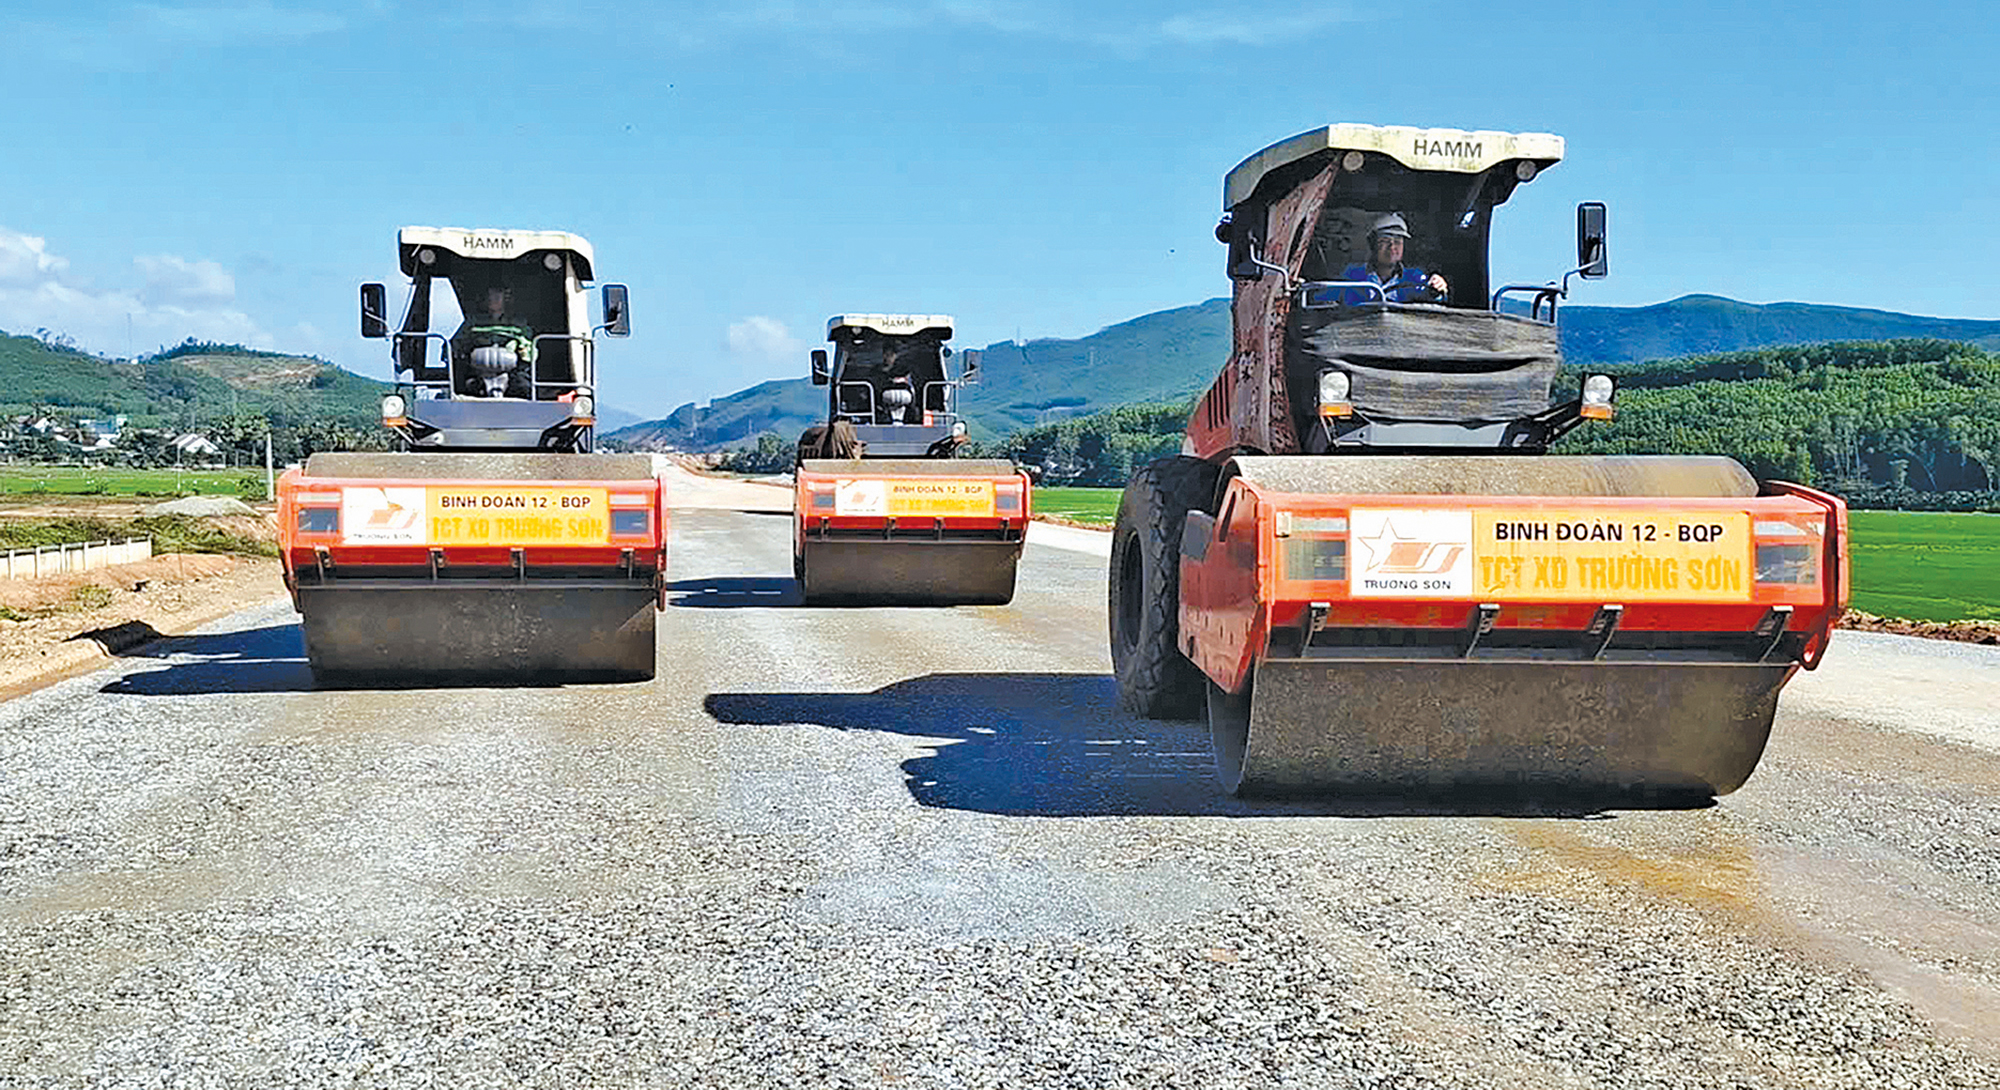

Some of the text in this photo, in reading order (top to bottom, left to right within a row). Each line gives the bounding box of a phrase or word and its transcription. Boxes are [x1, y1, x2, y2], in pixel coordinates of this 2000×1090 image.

[1413, 139, 1482, 158] HAMM
[463, 236, 514, 250] HAMM
[441, 495, 477, 508] BINH
[532, 496, 547, 508] 12
[561, 496, 591, 509] BQP
[1495, 522, 1549, 541] BINH
[1555, 518, 1623, 541] ĐOÀN
[1632, 524, 1657, 542] 12
[1678, 524, 1724, 543] BQP
[1479, 556, 1525, 589] TCT
